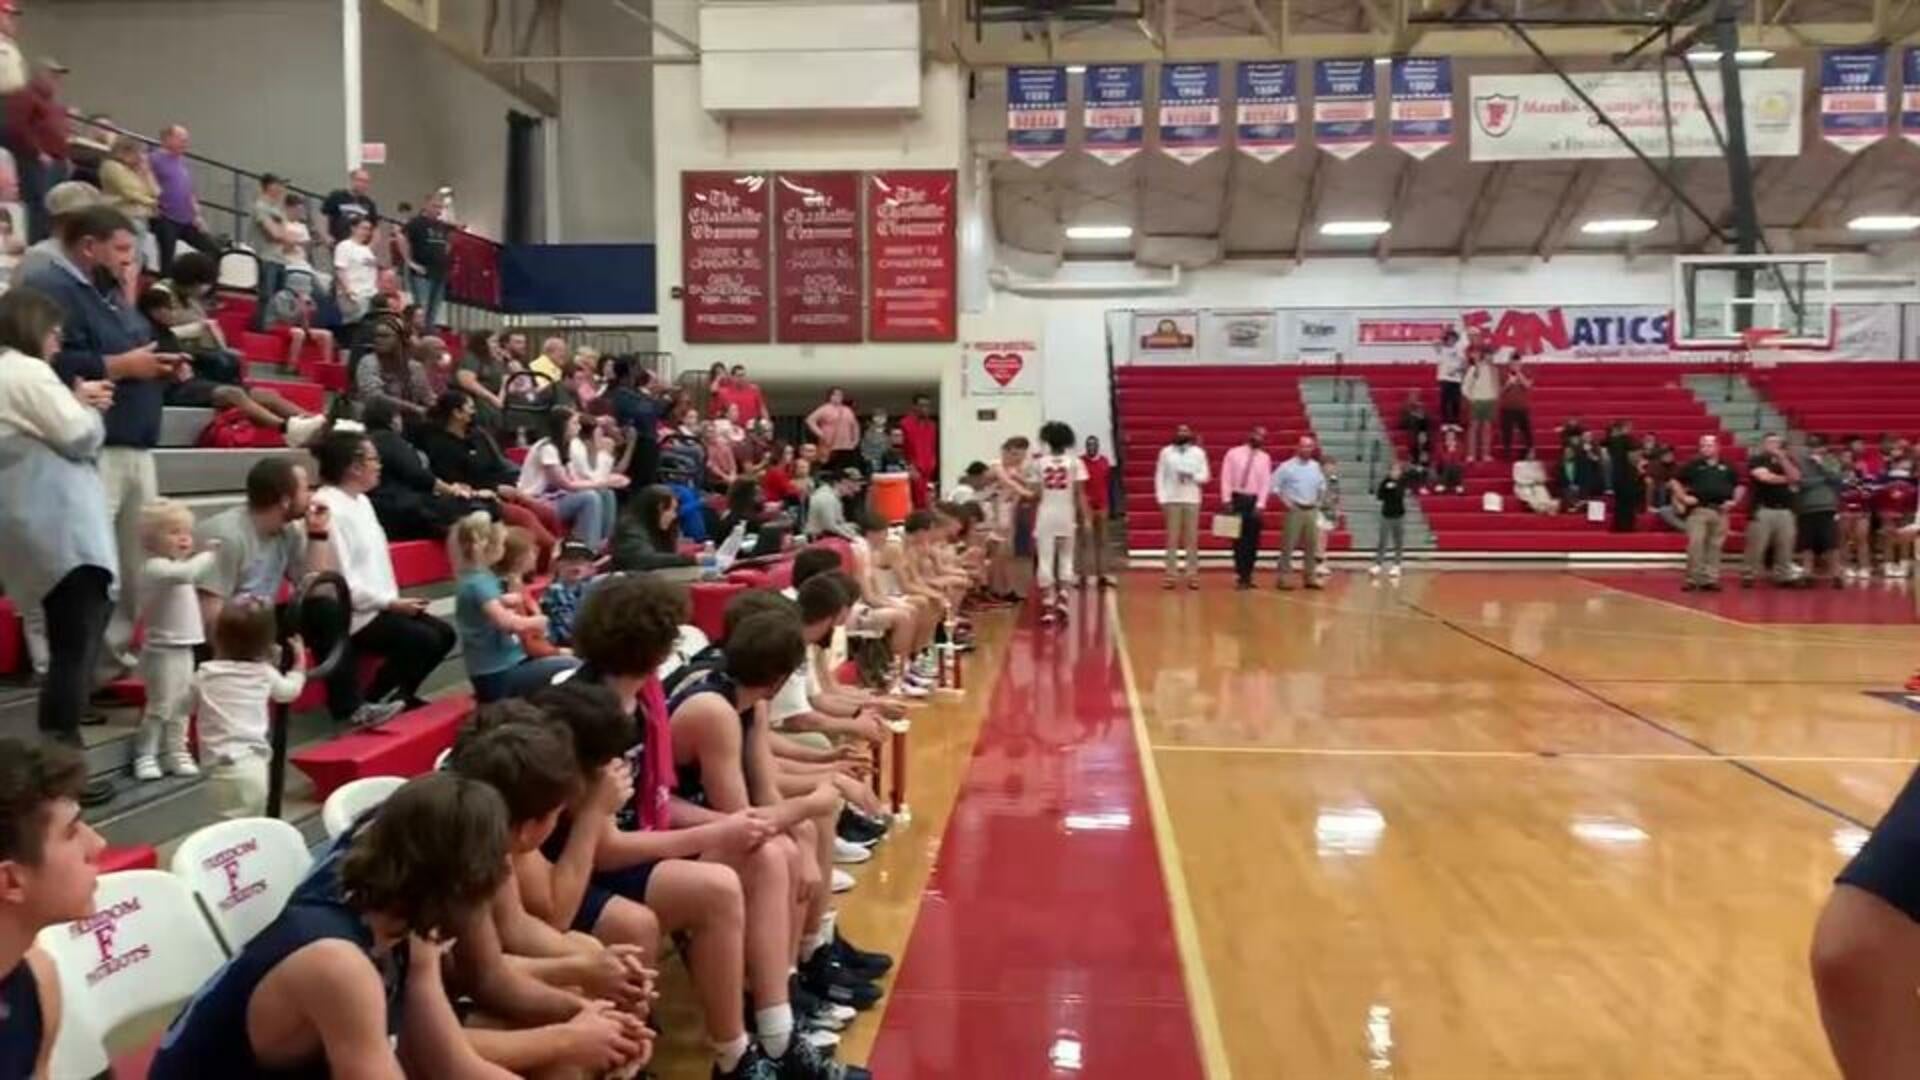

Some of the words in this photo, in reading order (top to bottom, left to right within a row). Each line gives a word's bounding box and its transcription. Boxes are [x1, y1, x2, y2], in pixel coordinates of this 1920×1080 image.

[1044, 466, 1067, 490] 22
[223, 860, 239, 897] F
[95, 924, 115, 962] F
